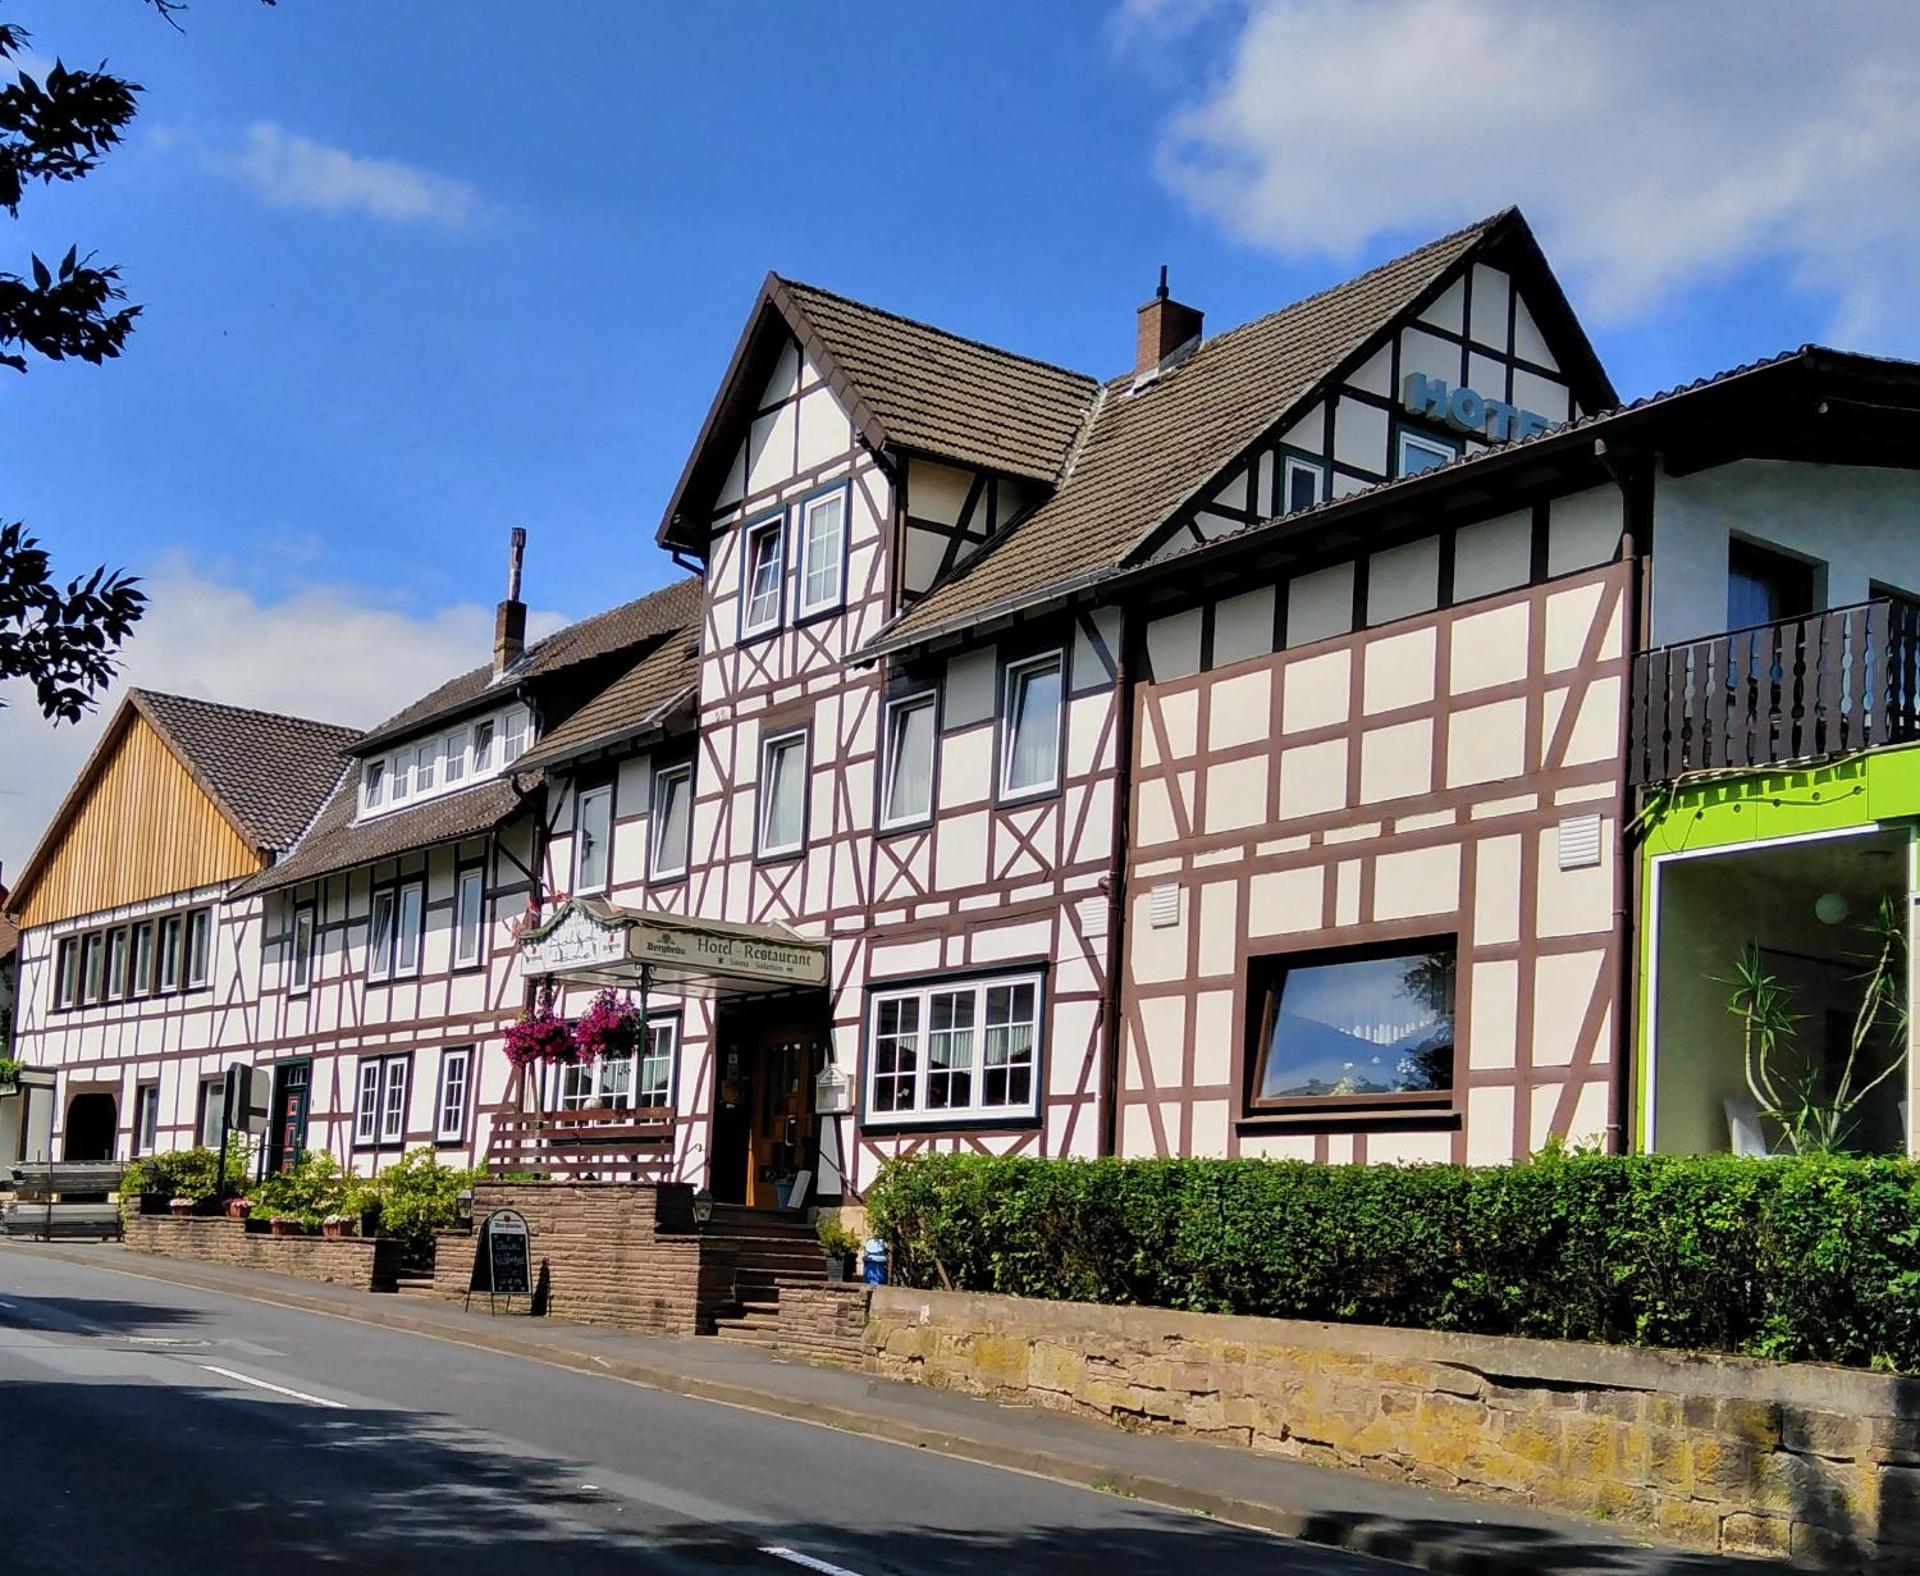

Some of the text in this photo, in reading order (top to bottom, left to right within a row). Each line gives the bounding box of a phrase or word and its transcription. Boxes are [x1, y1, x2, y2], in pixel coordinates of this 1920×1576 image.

[1404, 372, 1560, 442] HOTE
[698, 938, 811, 967] Hotel Restaurant
